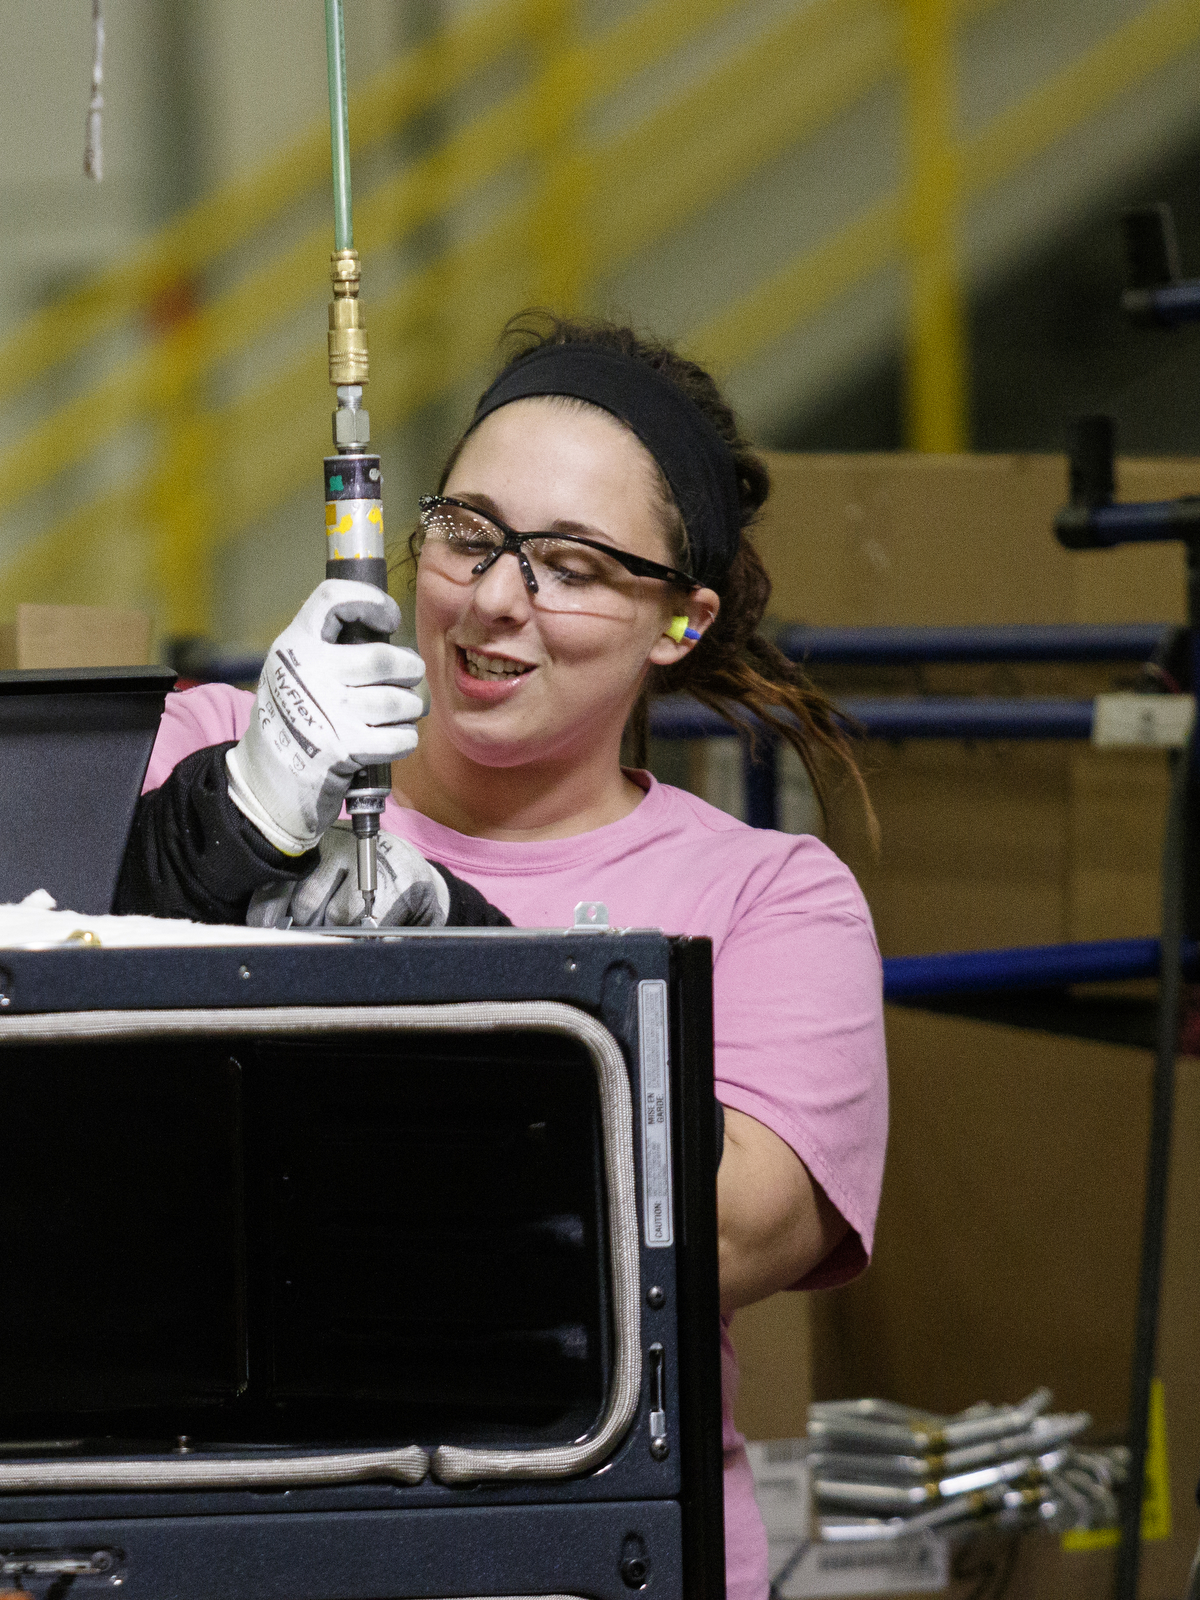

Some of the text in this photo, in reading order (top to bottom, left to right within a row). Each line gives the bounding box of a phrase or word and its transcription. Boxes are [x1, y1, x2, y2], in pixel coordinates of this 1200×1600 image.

[275, 666, 316, 727] HyFlex
[647, 1093, 655, 1125] MISE EN
[654, 1201, 663, 1239] CAUTION:
